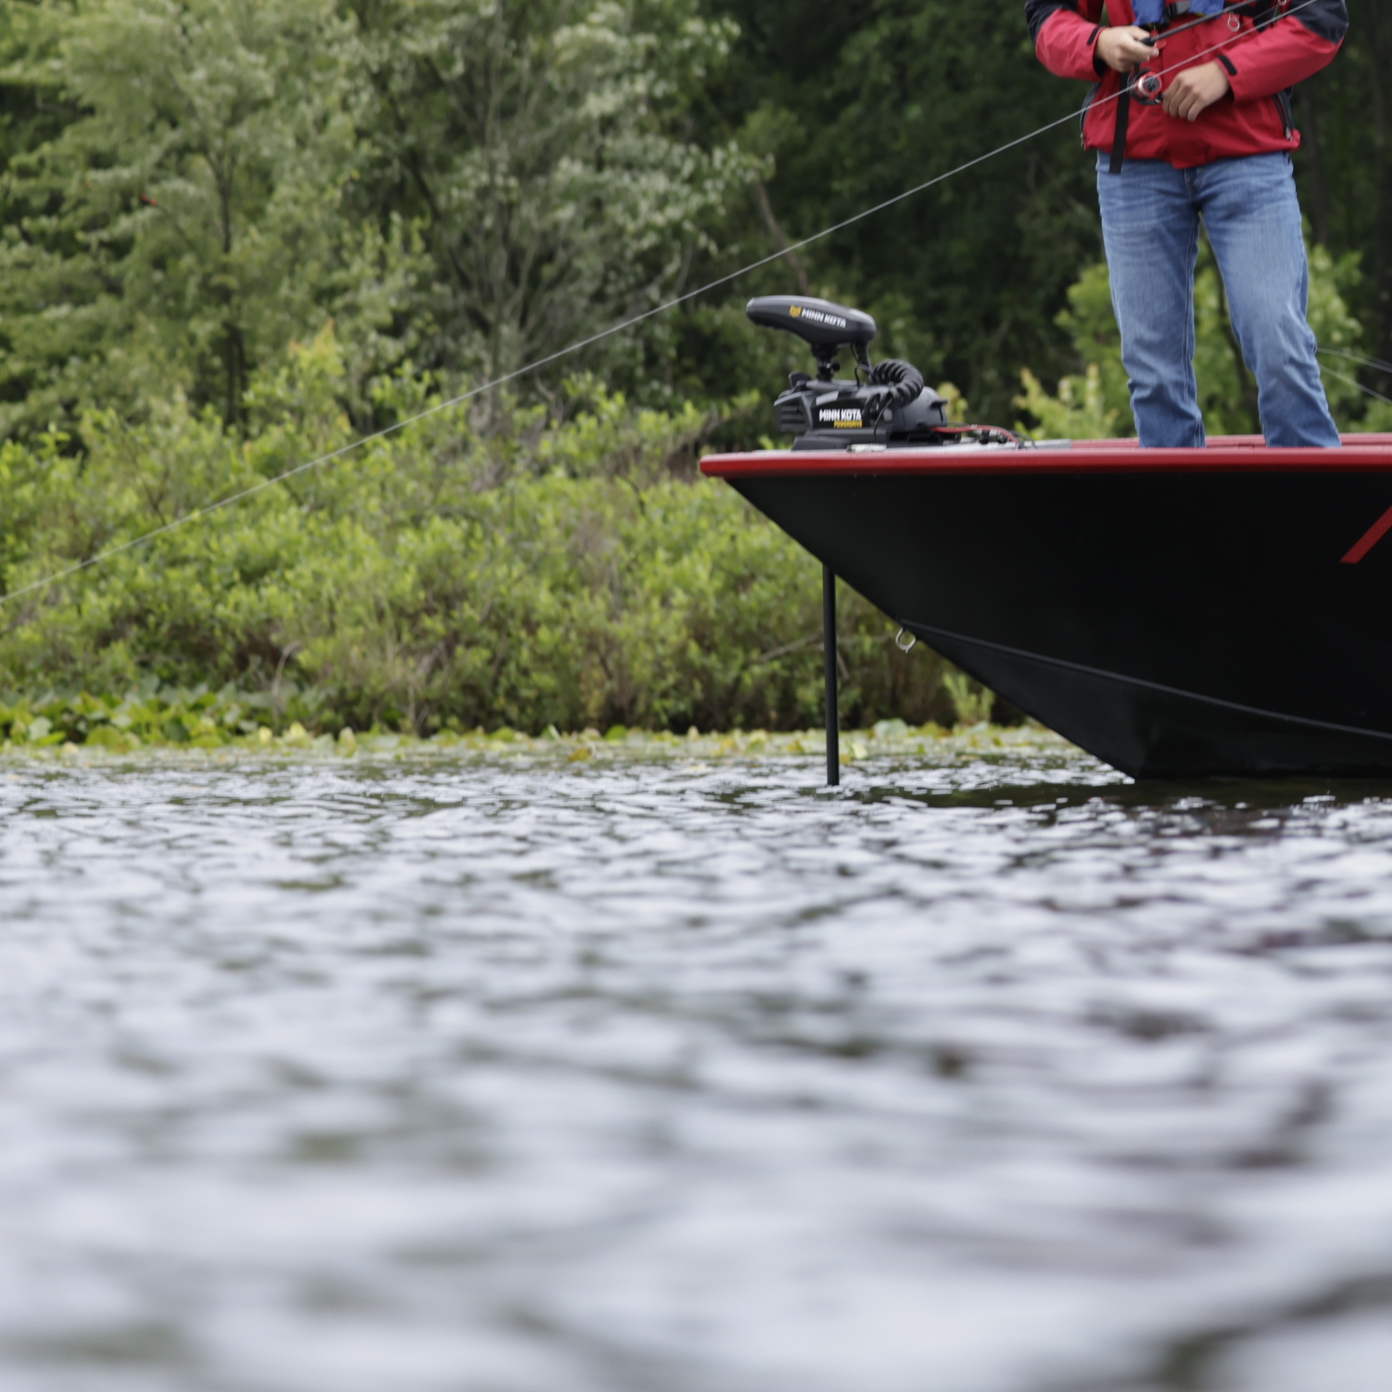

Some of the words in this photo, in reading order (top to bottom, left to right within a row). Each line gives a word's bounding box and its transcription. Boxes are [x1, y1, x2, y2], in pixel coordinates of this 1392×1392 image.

[801, 308, 824, 322] MINN
[824, 313, 846, 328] KOTA
[819, 409, 840, 421] MINN
[841, 409, 862, 421] KOTA
